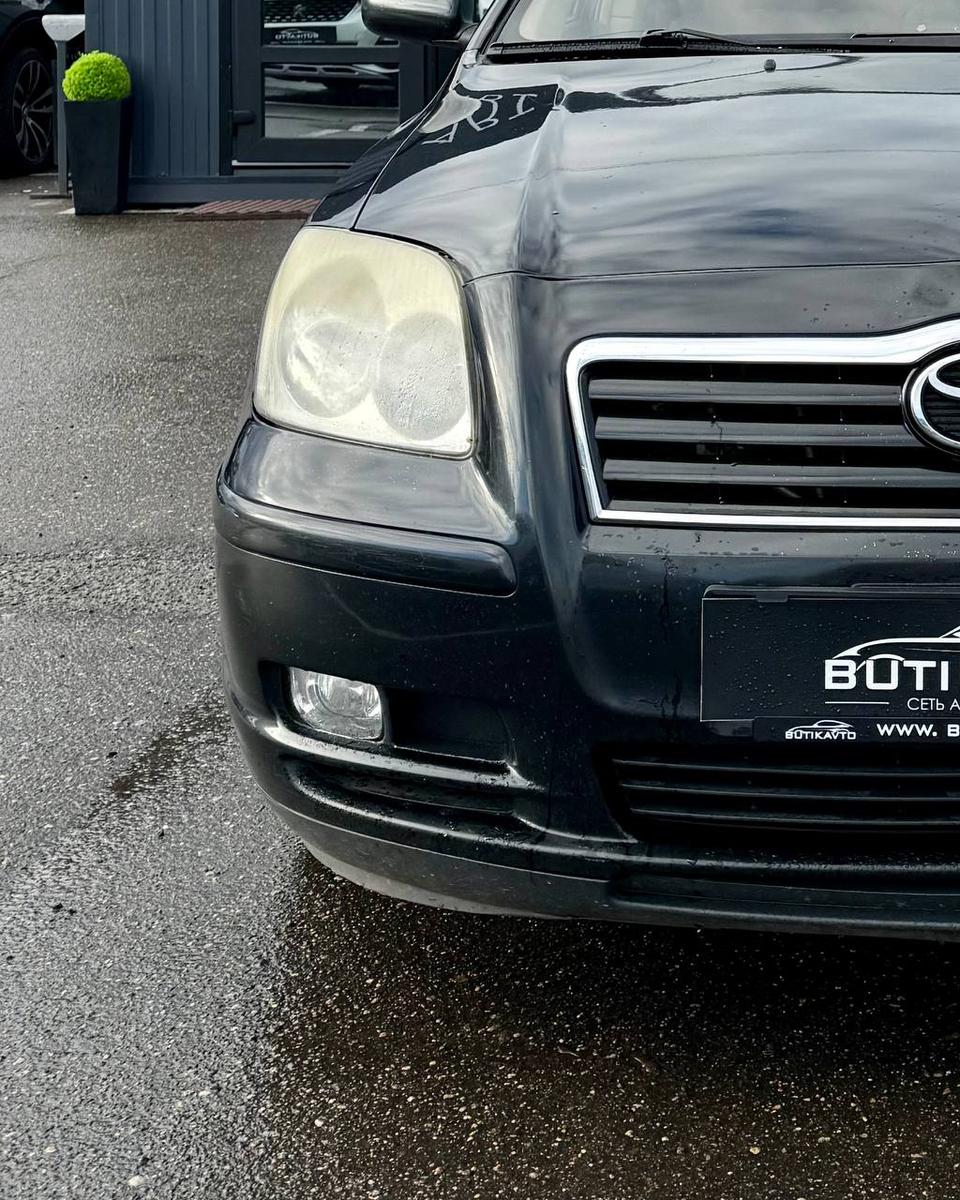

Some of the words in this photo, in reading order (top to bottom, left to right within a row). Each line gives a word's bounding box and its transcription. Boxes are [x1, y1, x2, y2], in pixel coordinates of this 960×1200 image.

[906, 698, 945, 712] СЕТЬ
[785, 731, 857, 740] BUTIKAVTO
[876, 723, 938, 737] WWW.
